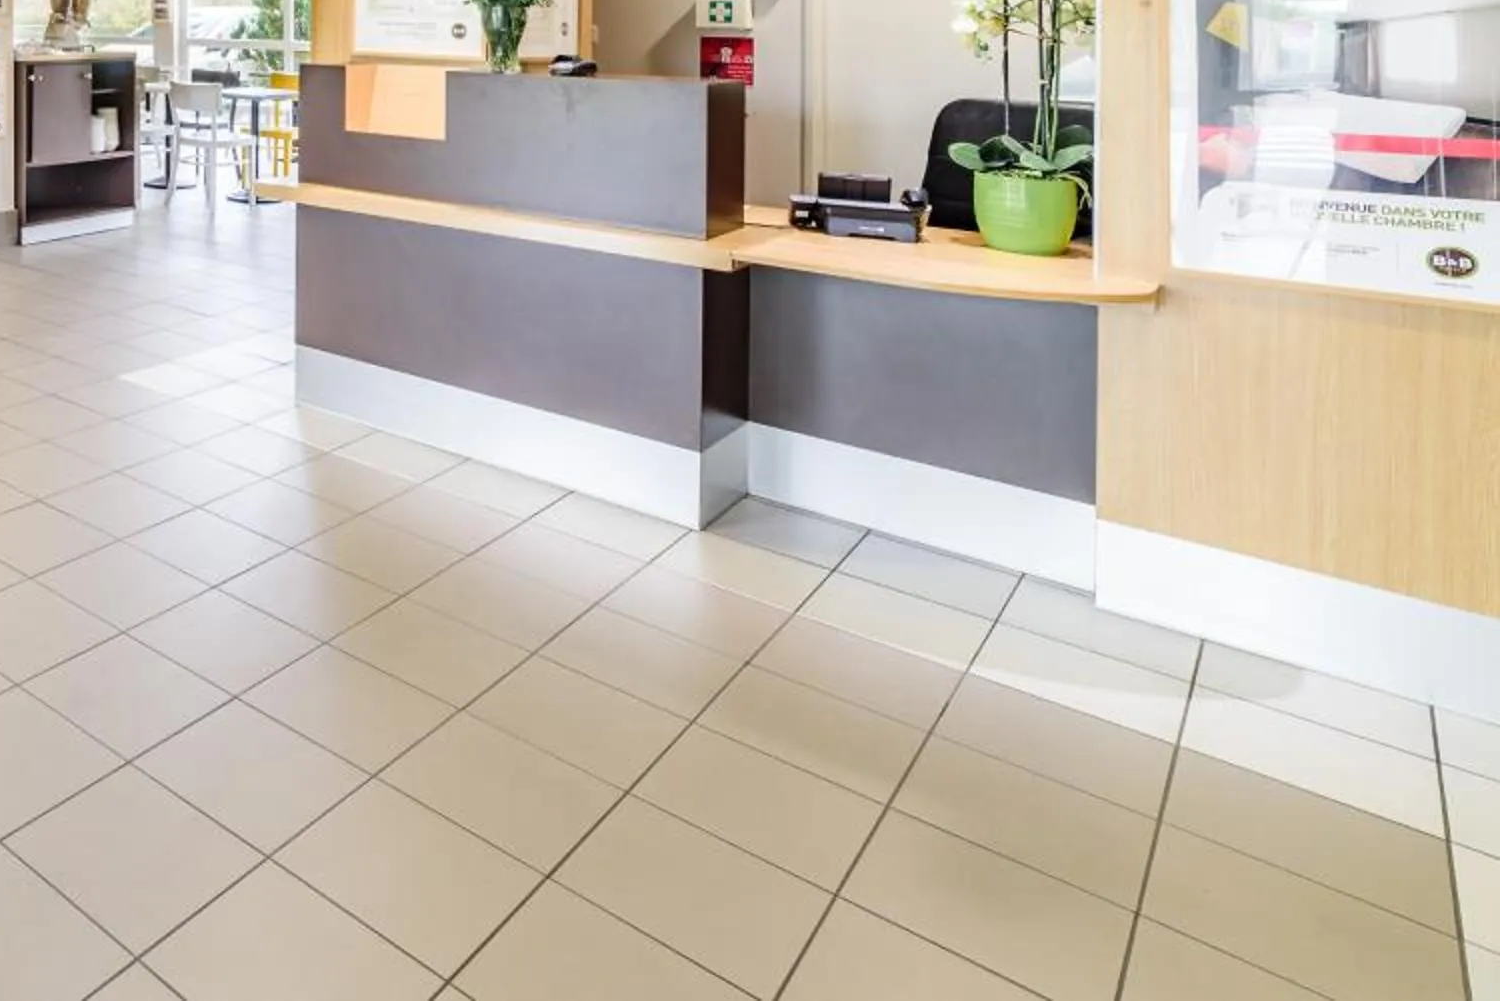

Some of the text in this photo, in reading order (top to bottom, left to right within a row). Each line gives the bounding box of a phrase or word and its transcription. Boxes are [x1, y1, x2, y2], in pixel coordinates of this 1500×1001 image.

[1381, 204, 1428, 219] DANS
[1430, 208, 1487, 224] VOTRE
[1373, 215, 1457, 232] CHAMBRE
